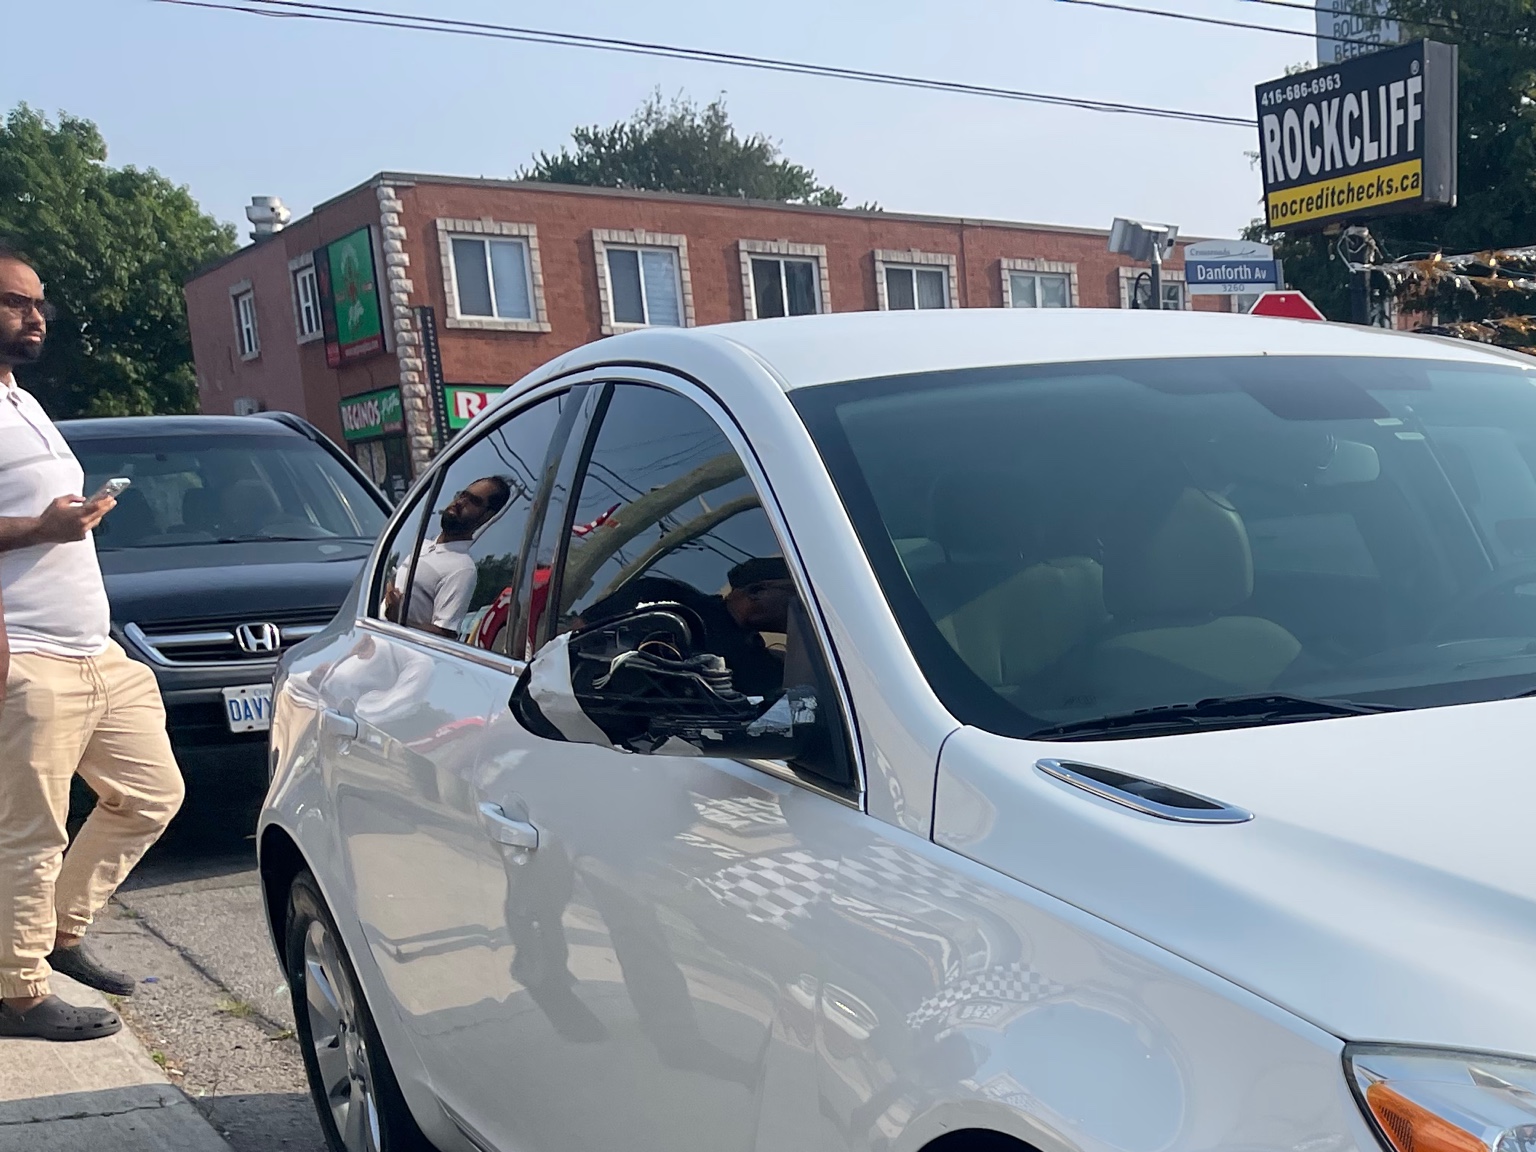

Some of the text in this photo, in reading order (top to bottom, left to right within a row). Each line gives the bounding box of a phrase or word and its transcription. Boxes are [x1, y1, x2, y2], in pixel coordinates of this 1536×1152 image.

[1261, 73, 1341, 106] 416-686-6963
[1262, 76, 1422, 184] ROCKCLIFF
[1271, 170, 1420, 220] nocreditchecks.ca
[1197, 264, 1267, 280] Danforth Av
[1222, 284, 1245, 292] 3260
